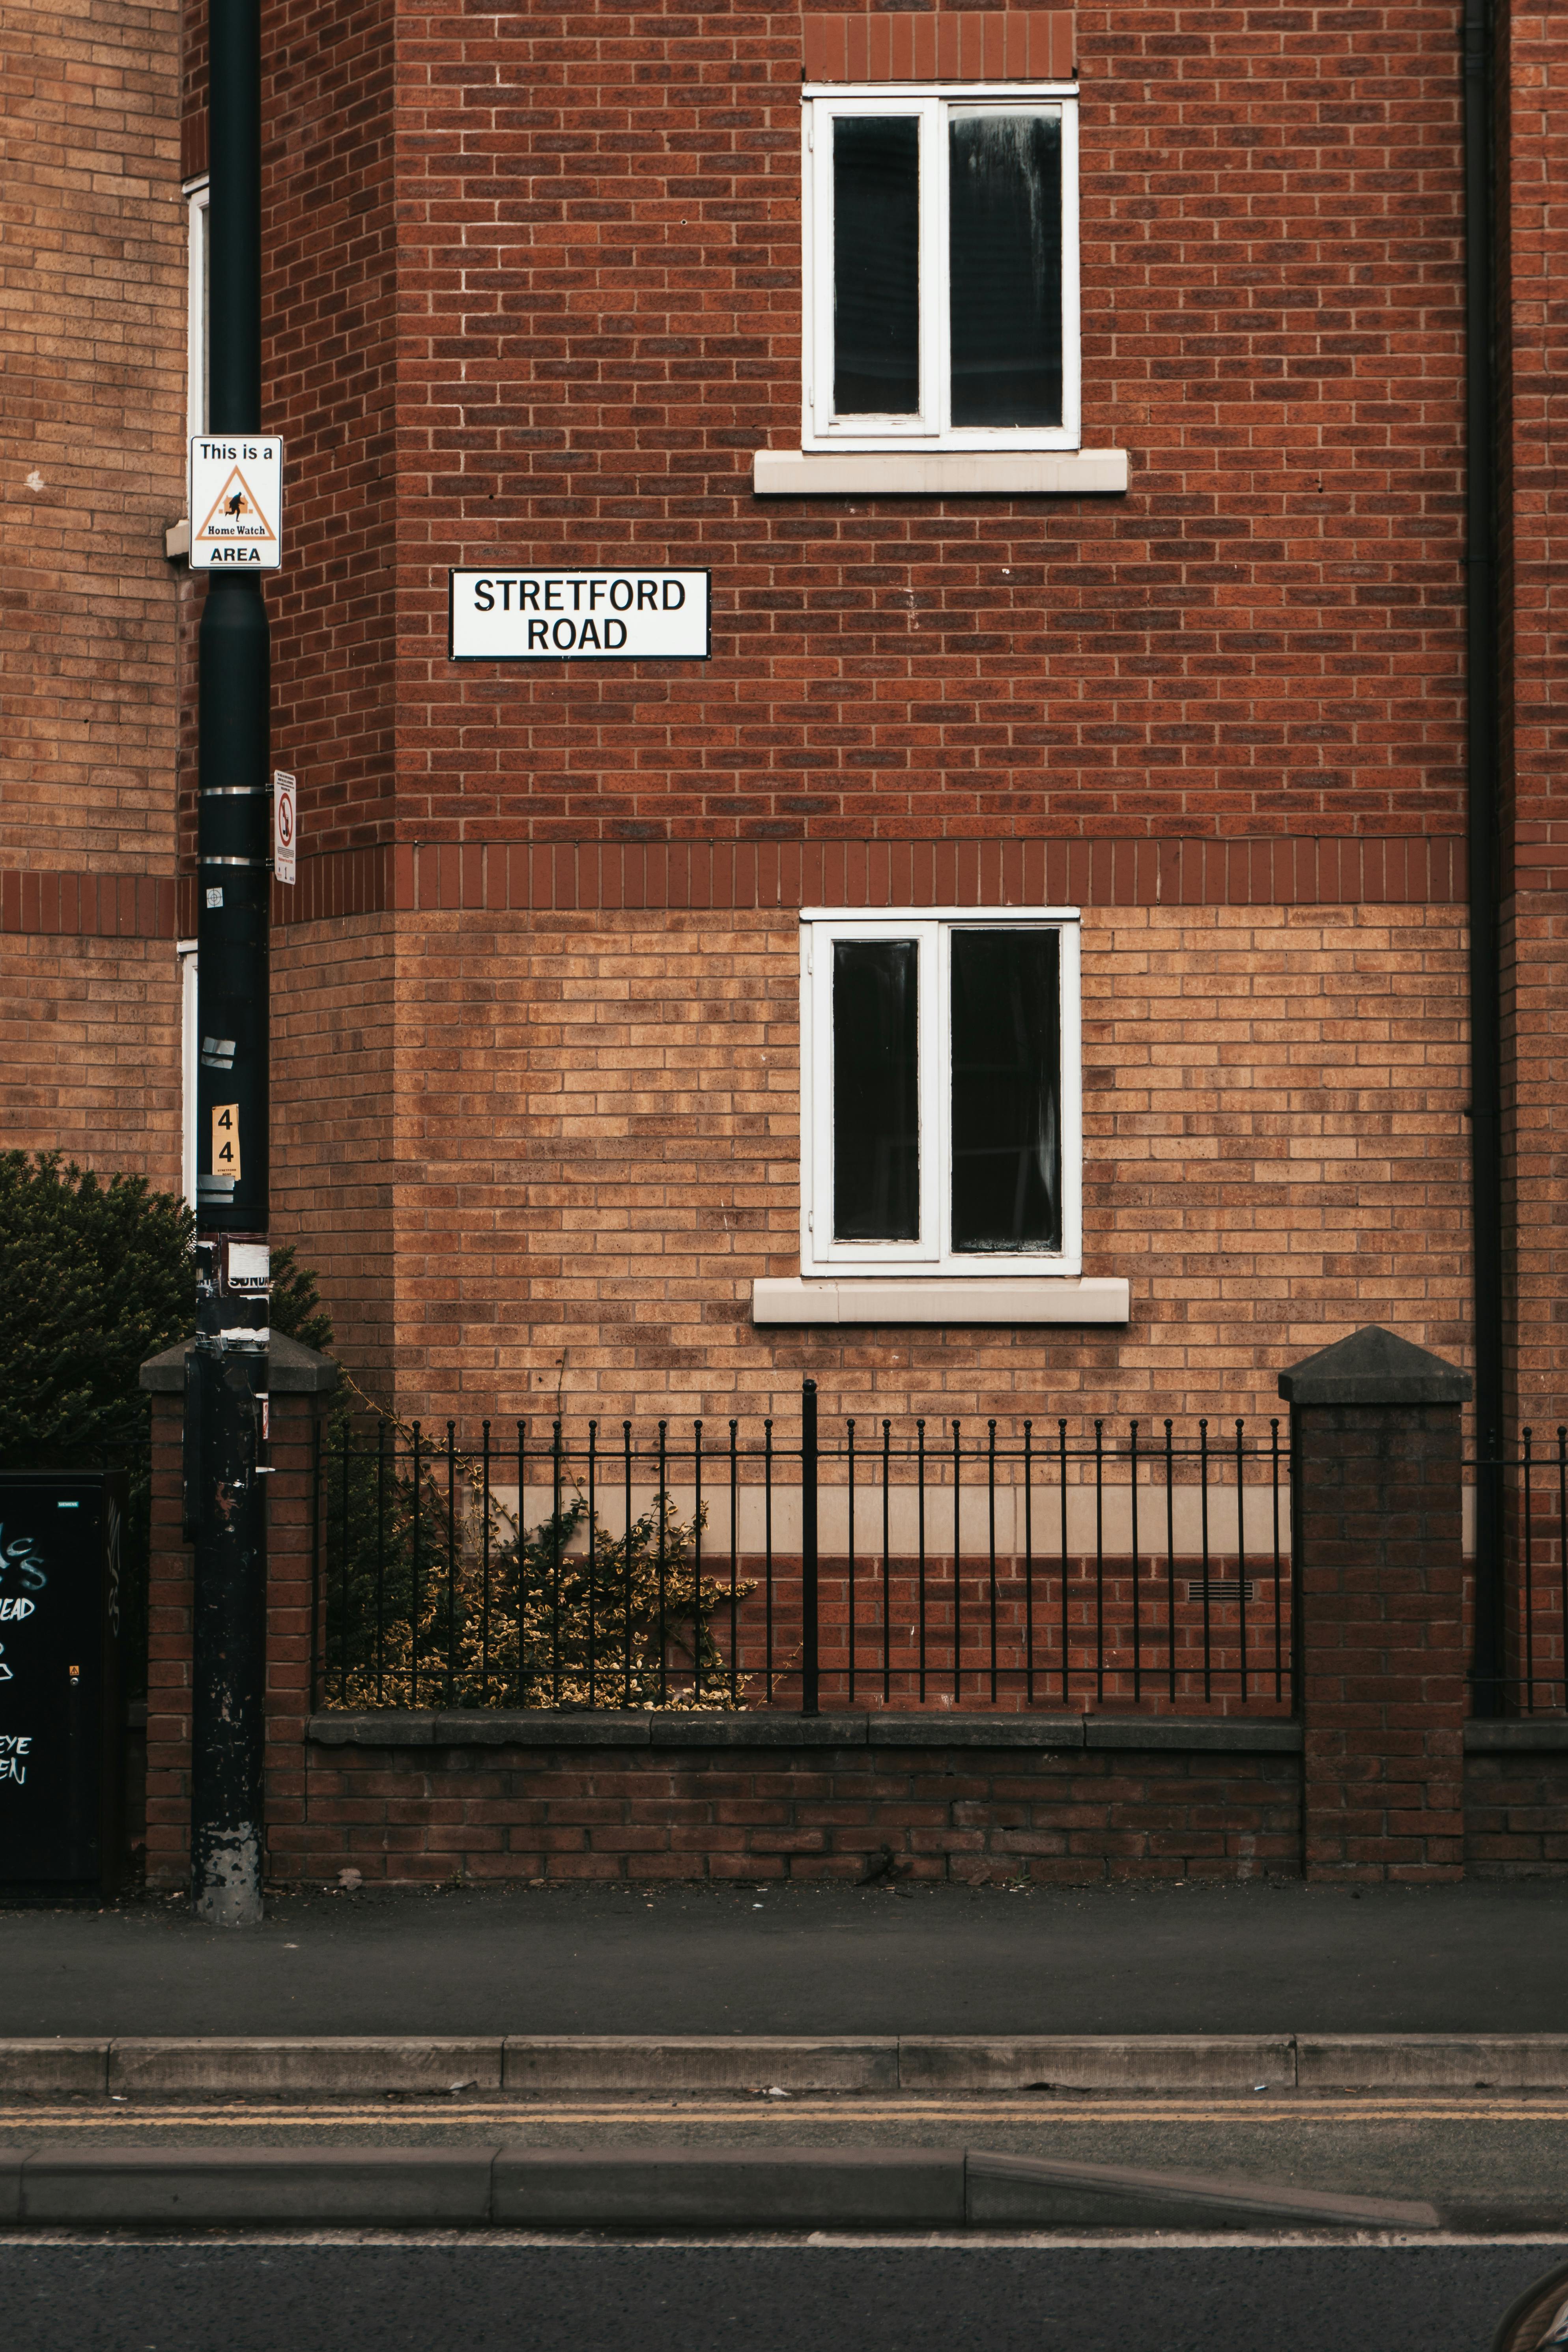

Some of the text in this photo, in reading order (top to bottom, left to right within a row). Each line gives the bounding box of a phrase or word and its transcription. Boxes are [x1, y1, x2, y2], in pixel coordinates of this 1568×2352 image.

[200, 444, 273, 459] This is a
[208, 526, 265, 535] Home Watch
[210, 548, 261, 561] AREA
[474, 579, 686, 611] STRETFORD
[528, 618, 627, 650] ROAD
[218, 1109, 233, 1130] 4
[219, 1141, 234, 1162] 4
[0, 1598, 36, 1621] EAD
